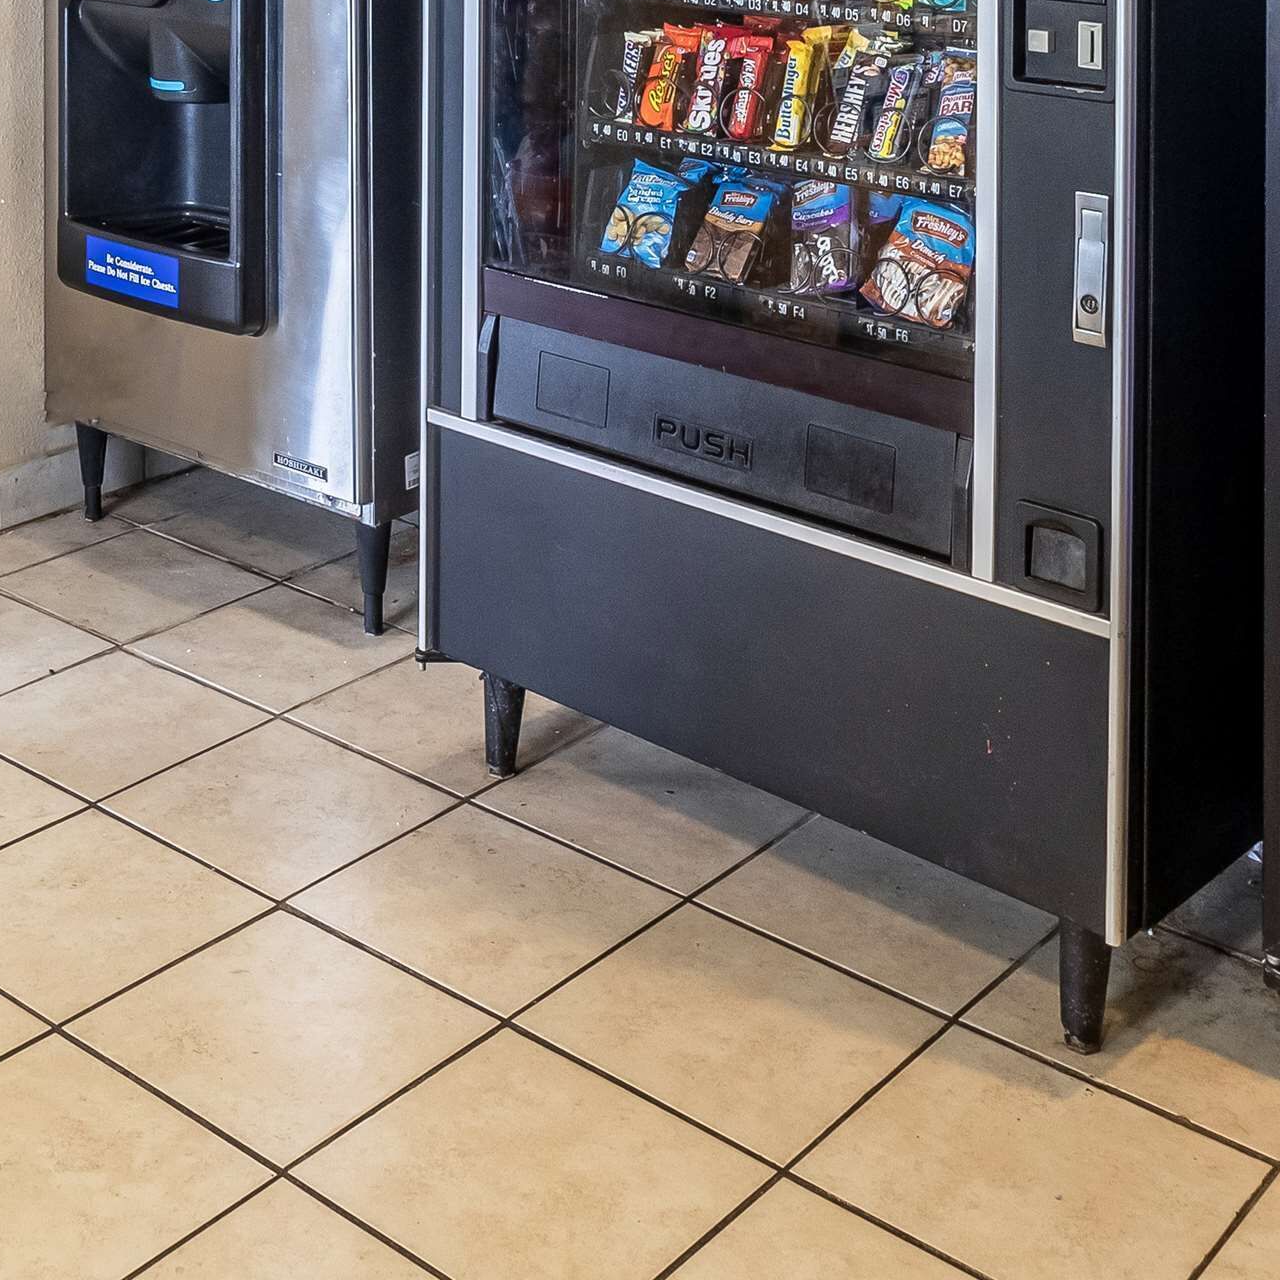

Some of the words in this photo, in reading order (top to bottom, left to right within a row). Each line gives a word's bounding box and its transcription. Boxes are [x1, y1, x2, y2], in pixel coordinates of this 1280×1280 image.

[940, 101, 973, 116] BAR
[617, 129, 627, 141] E0
[701, 144, 713, 155] E2
[749, 153, 760, 164] E3
[796, 159, 808, 172] E4
[845, 168, 858, 180] E5
[895, 176, 909, 189] E6
[949, 184, 963, 197] E7
[917, 215, 966, 242] Freshley's
[106, 265, 115, 277] Do
[116, 268, 128, 281] Not
[705, 287, 717, 299] F2
[793, 306, 804, 319] F4
[895, 330, 909, 342] F6
[656, 419, 752, 467] PUSH
